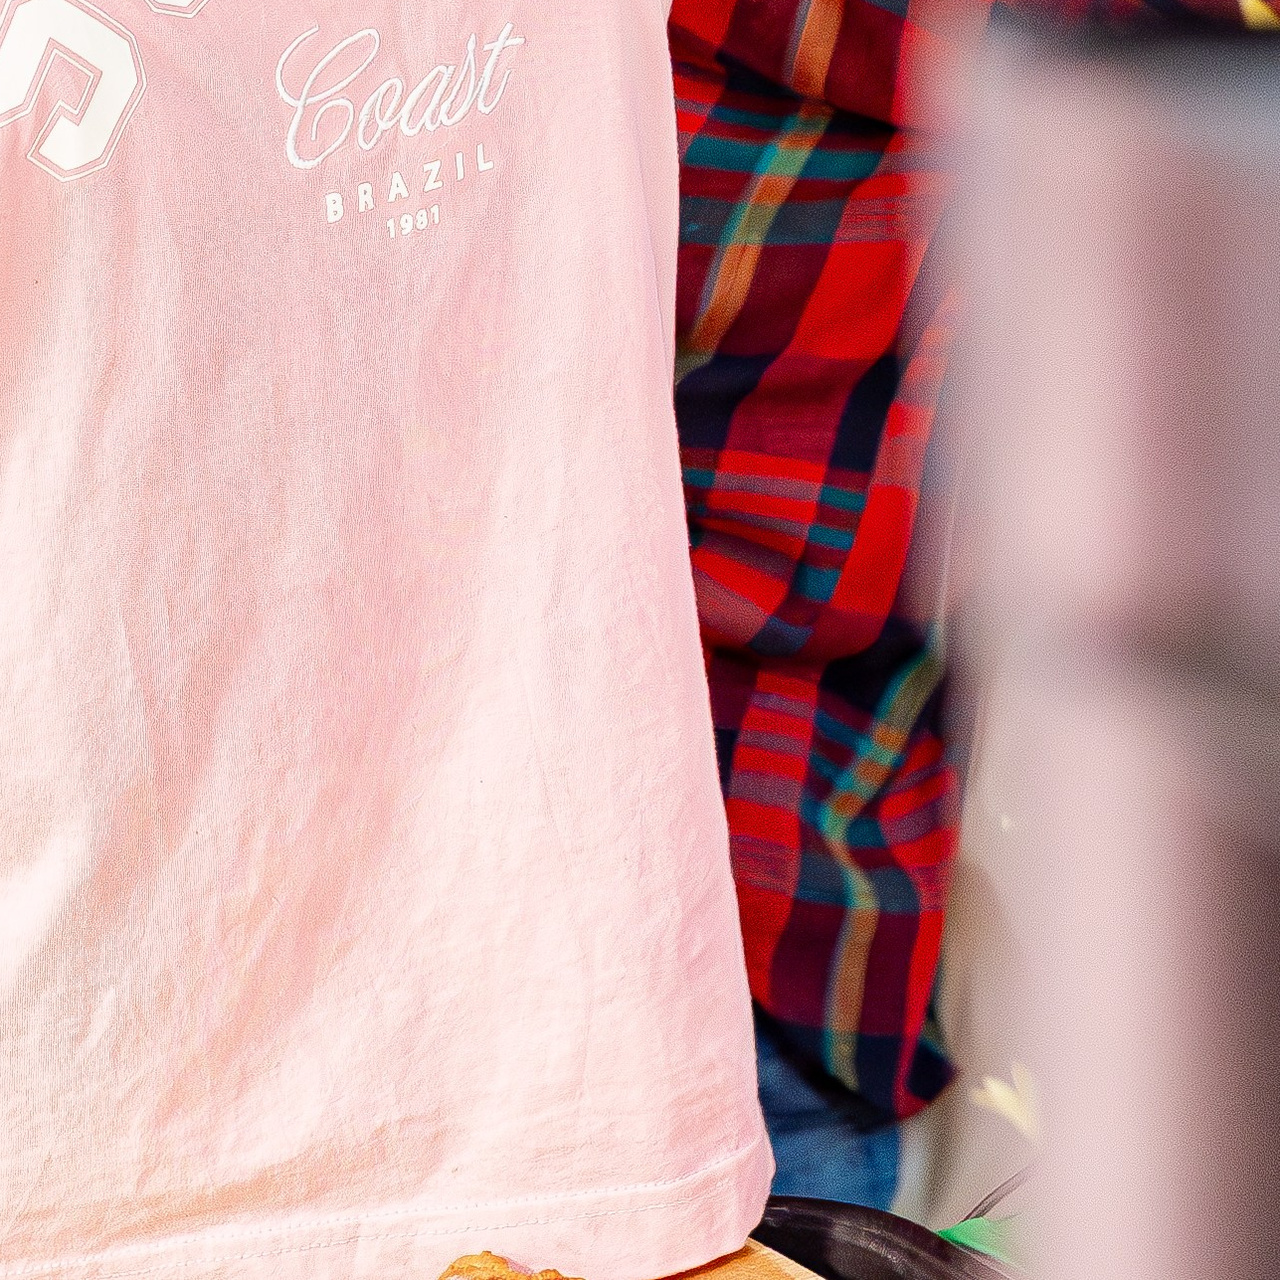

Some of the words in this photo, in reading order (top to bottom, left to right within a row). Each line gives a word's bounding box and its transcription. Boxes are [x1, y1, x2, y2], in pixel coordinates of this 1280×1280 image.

[275, 21, 526, 170] Coast
[324, 142, 495, 225] BRAZIL
[385, 203, 441, 240] 1981
